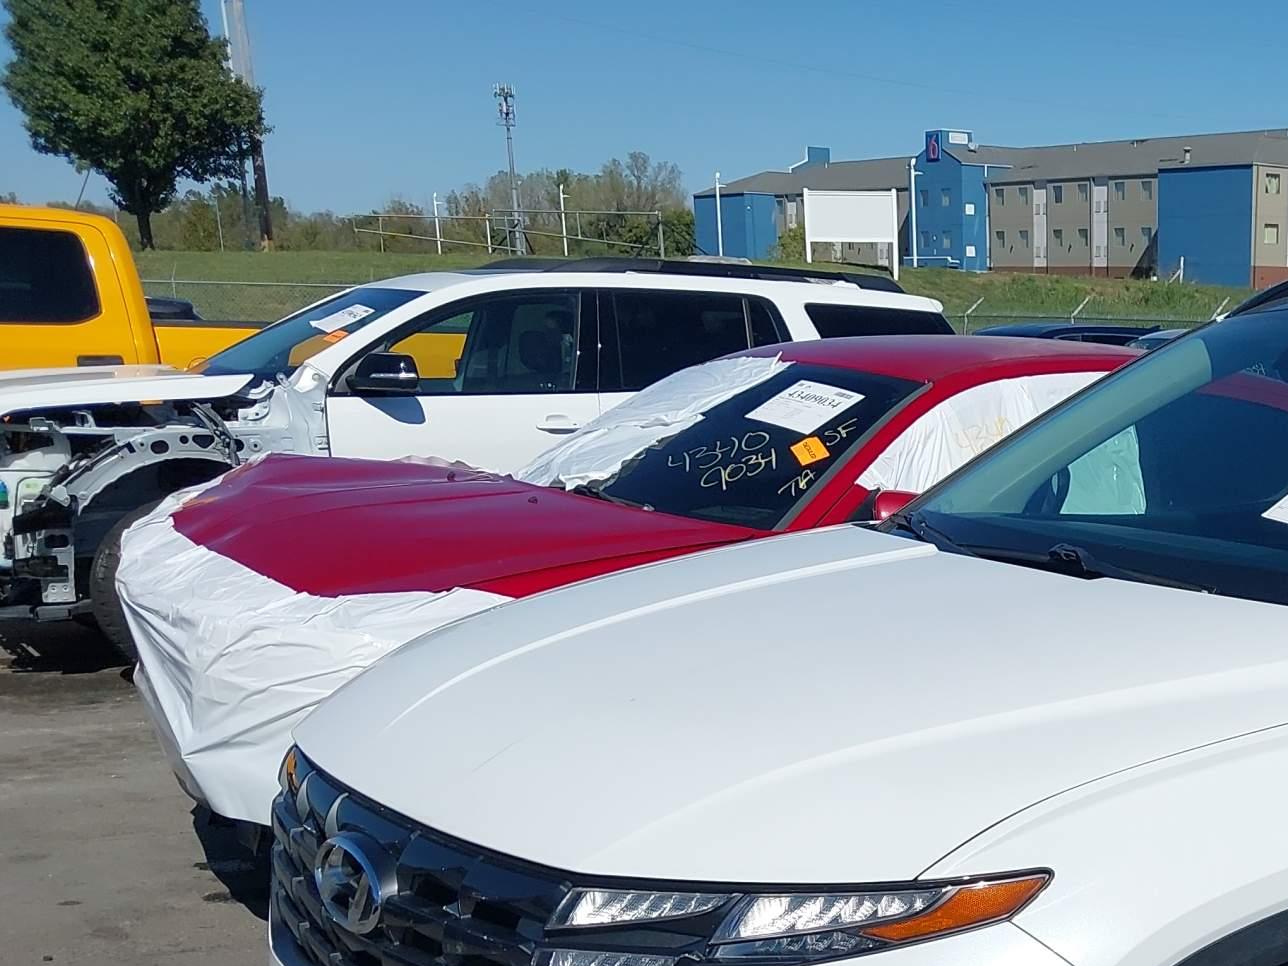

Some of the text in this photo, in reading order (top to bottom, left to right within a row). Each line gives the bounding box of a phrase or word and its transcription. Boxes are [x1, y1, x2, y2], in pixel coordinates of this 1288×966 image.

[928, 133, 939, 159] 6
[788, 390, 843, 409] 43409034
[667, 431, 770, 473] 4340
[700, 447, 777, 491] 9034
